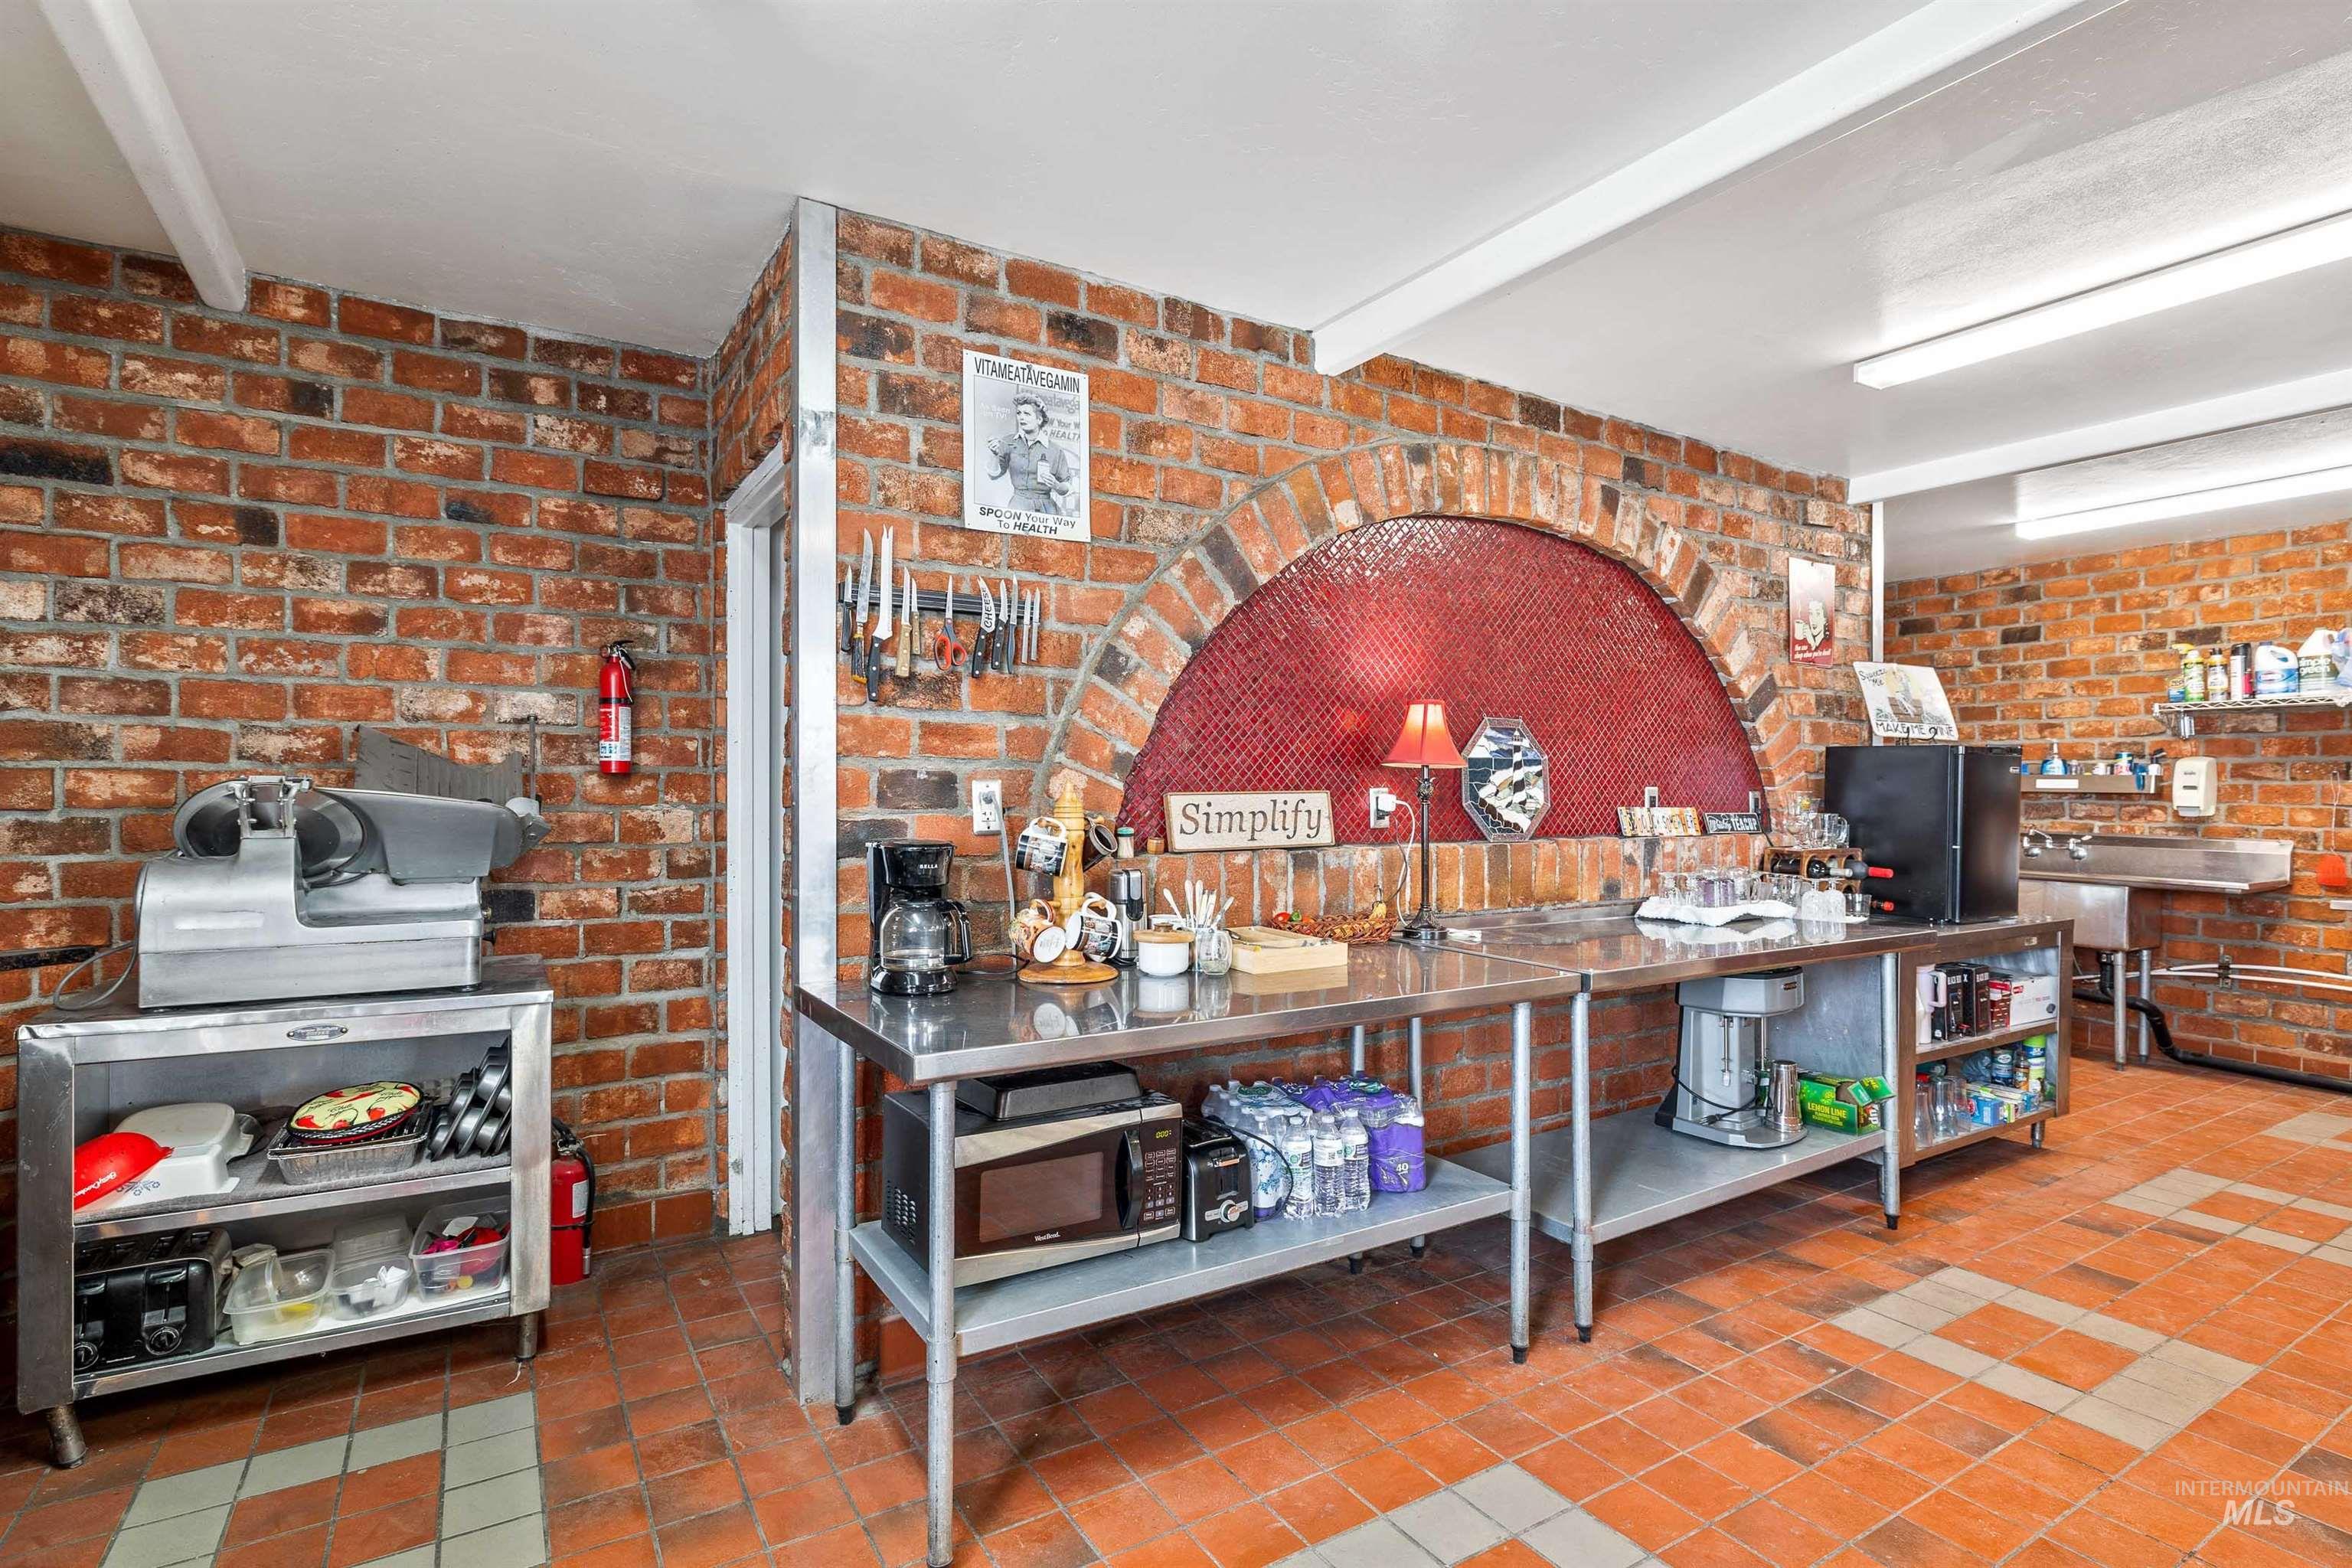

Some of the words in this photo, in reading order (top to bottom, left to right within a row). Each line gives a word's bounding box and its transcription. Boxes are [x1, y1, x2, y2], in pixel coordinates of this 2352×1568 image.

[975, 357, 1080, 394] VITAMEATAVEGAMIN
[979, 506, 1021, 521] SPOON
[1025, 512, 1049, 524] Your
[1053, 516, 1076, 529] Way
[998, 519, 1010, 529] To
[1013, 521, 1057, 534] HEALTH
[1179, 799, 1322, 841] Simplify
[1730, 818, 1758, 831] TEACUP
[1396, 1162, 1409, 1172] 40
